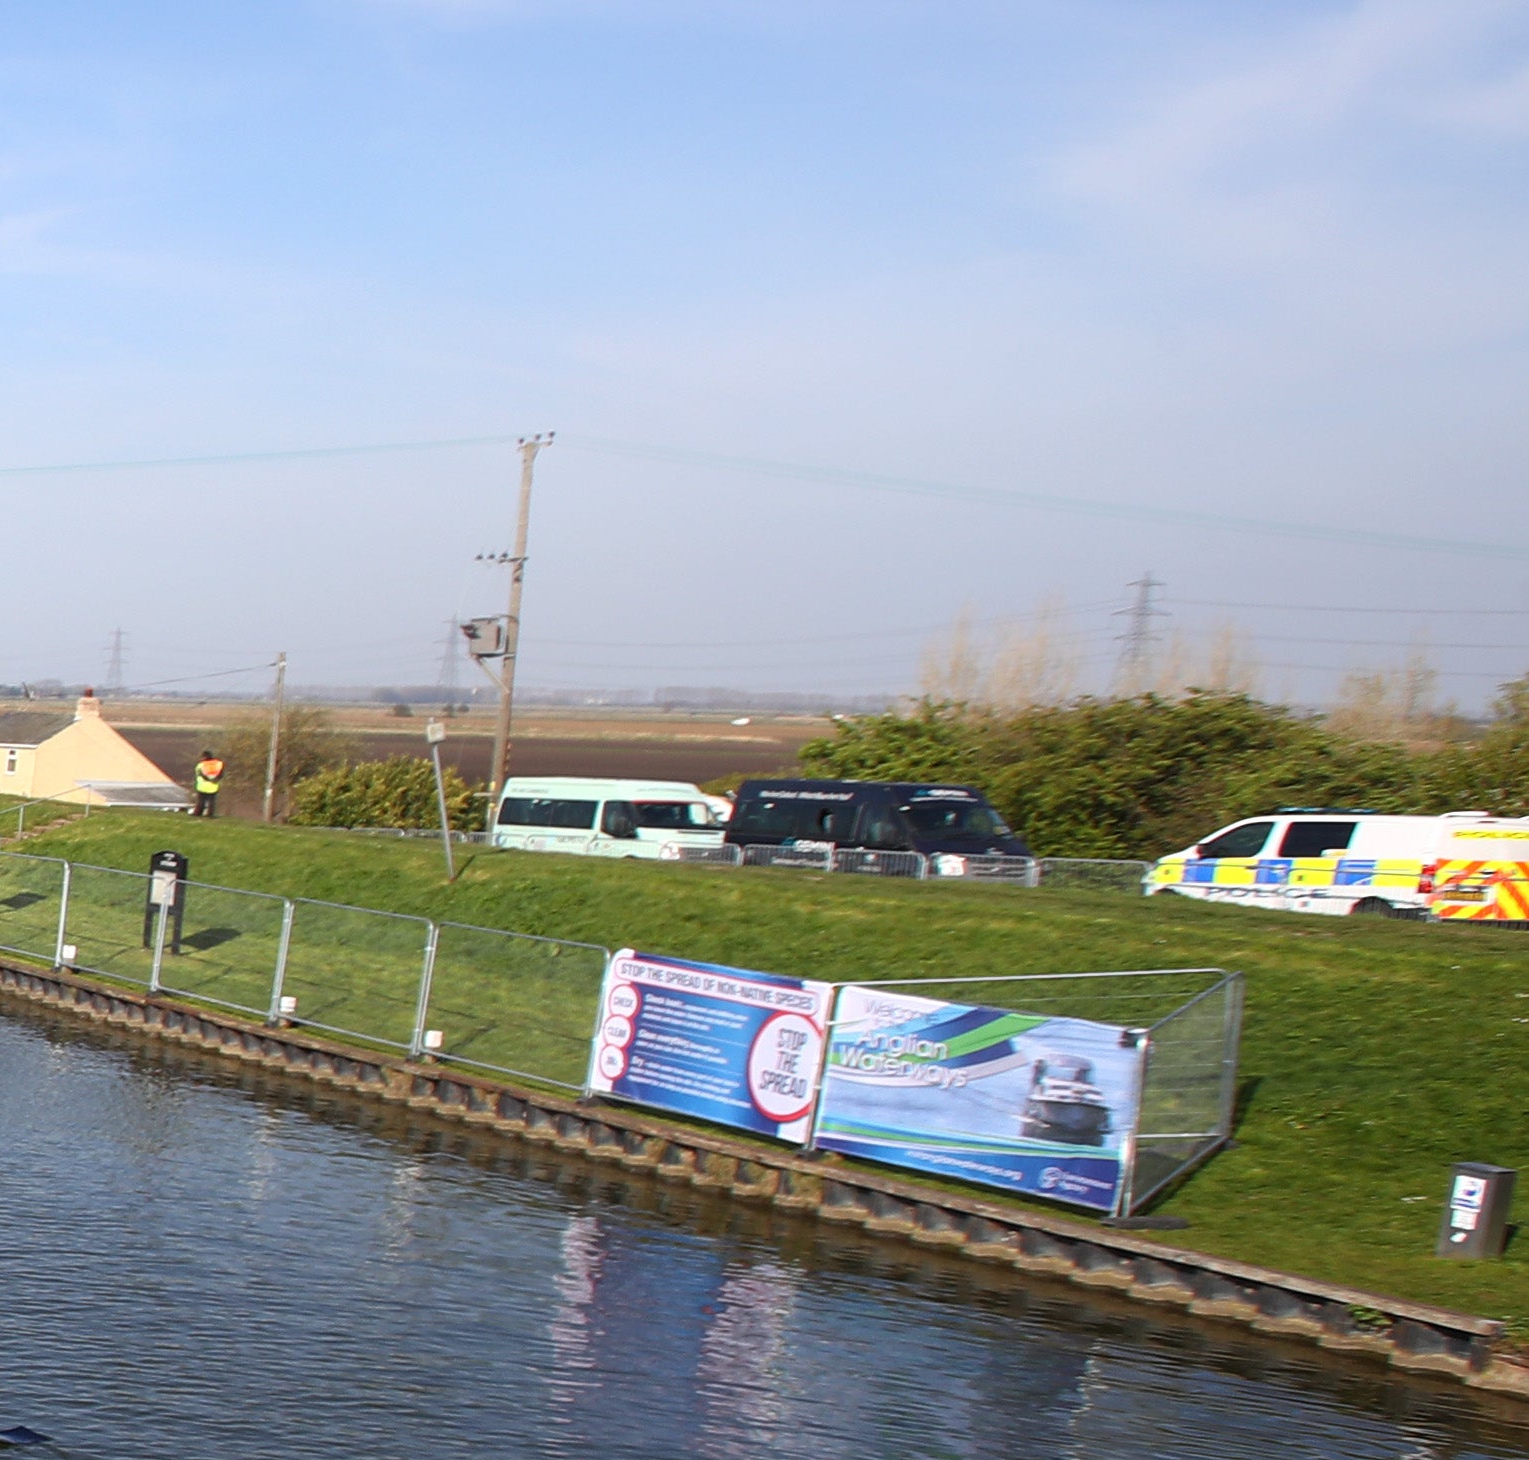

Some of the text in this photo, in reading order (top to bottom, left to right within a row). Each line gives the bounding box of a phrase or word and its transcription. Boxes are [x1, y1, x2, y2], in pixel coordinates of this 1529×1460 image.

[621, 963, 814, 1010] STOP THE SPREAD OF NON-NATIVE SPECIES
[779, 1028, 808, 1049] STOP
[857, 1028, 948, 1060] Anglian
[778, 1051, 800, 1074] THE
[842, 1044, 968, 1089] Waterways
[759, 1070, 808, 1099] SPREAD
